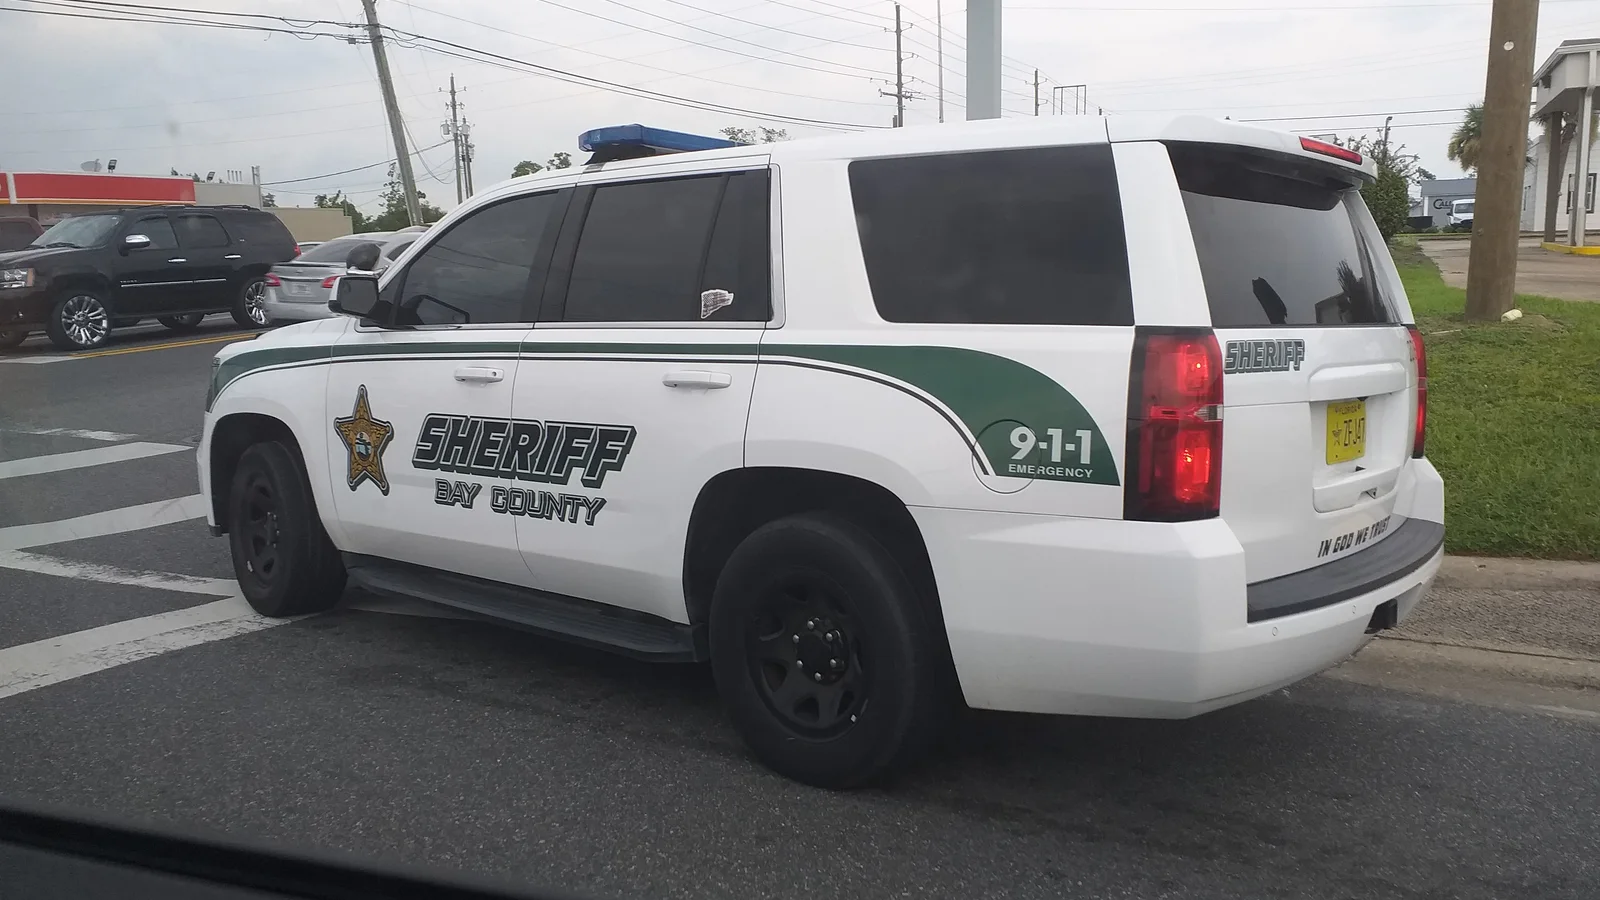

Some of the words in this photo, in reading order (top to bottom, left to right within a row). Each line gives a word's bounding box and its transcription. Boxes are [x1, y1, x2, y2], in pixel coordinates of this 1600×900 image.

[1224, 339, 1305, 374] SHERIFF
[411, 413, 637, 489] SHERIFF
[1010, 426, 1091, 464] 9-1-1
[1008, 463, 1093, 478] EMERGENCY
[434, 477, 482, 509] BAY
[490, 485, 607, 526] COUNTY
[1317, 538, 1332, 558] IN
[1332, 532, 1354, 553] GOD
[1354, 526, 1369, 546] WE
[1369, 515, 1391, 540] TRUST
